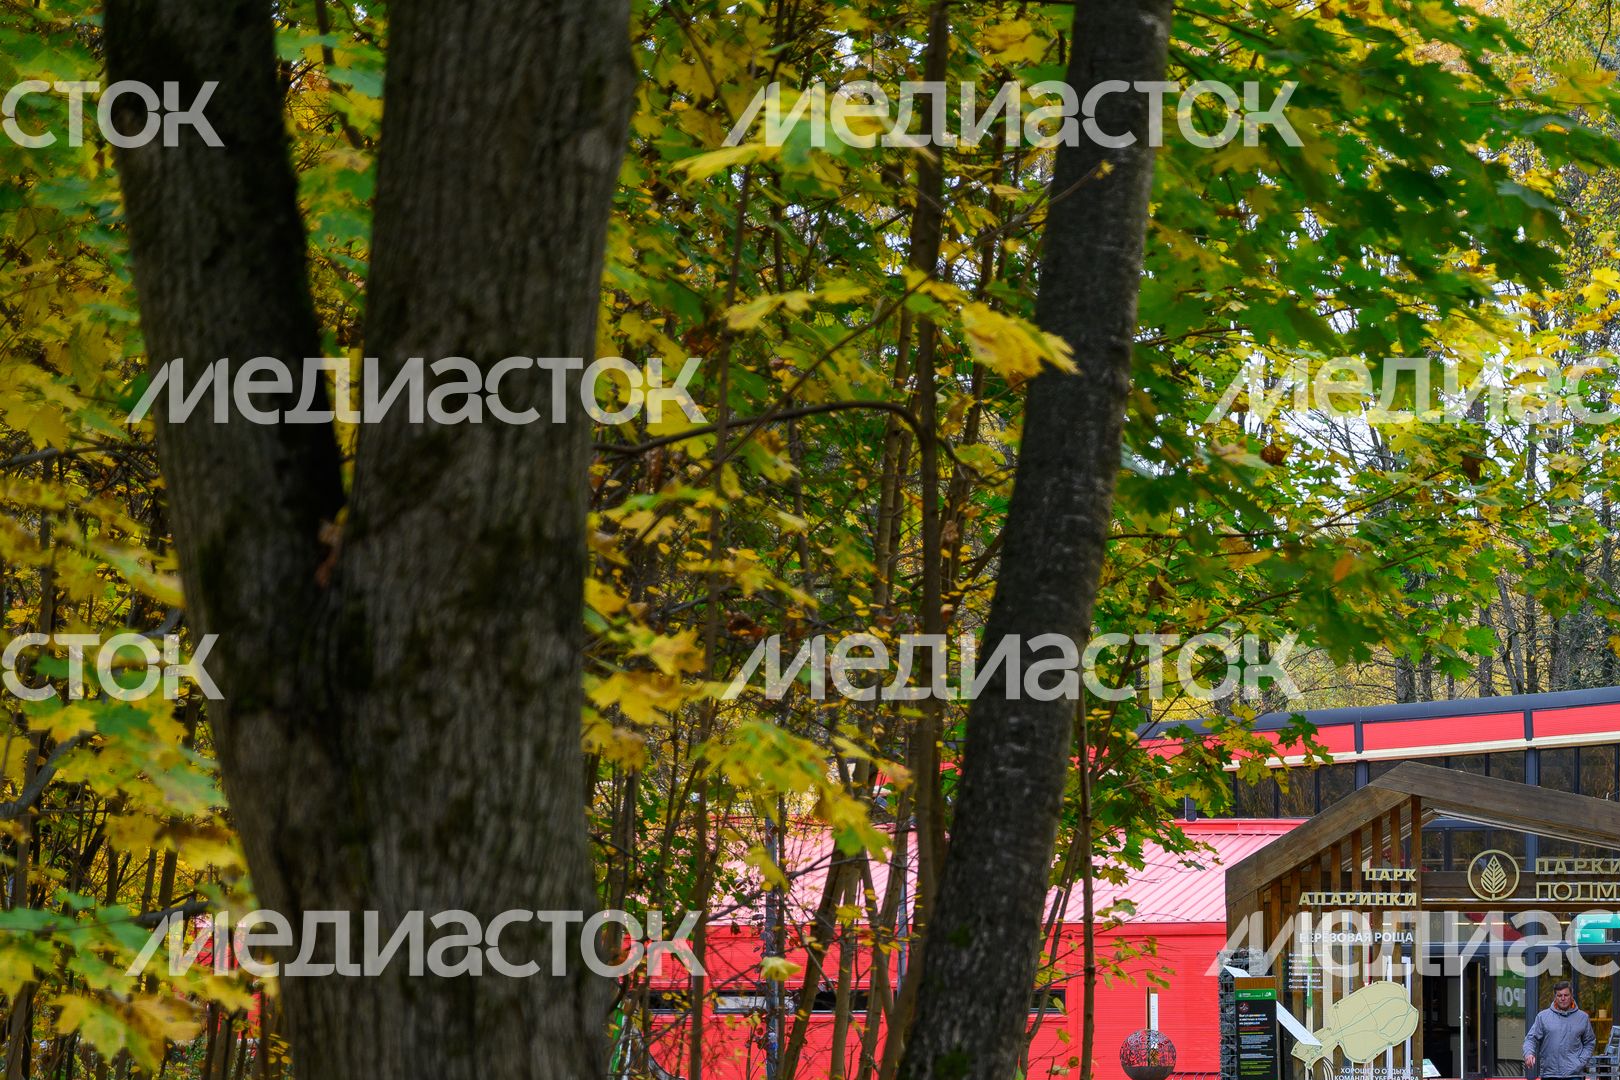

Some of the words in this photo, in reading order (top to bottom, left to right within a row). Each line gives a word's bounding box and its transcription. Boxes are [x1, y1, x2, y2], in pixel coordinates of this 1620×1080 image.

[1365, 868, 1417, 881] ПАРК
[1298, 891, 1417, 906] АПАРИНКИ
[1374, 931, 1414, 944] РОЩА
[1340, 1067, 1380, 1076] ХОРОШЕО
